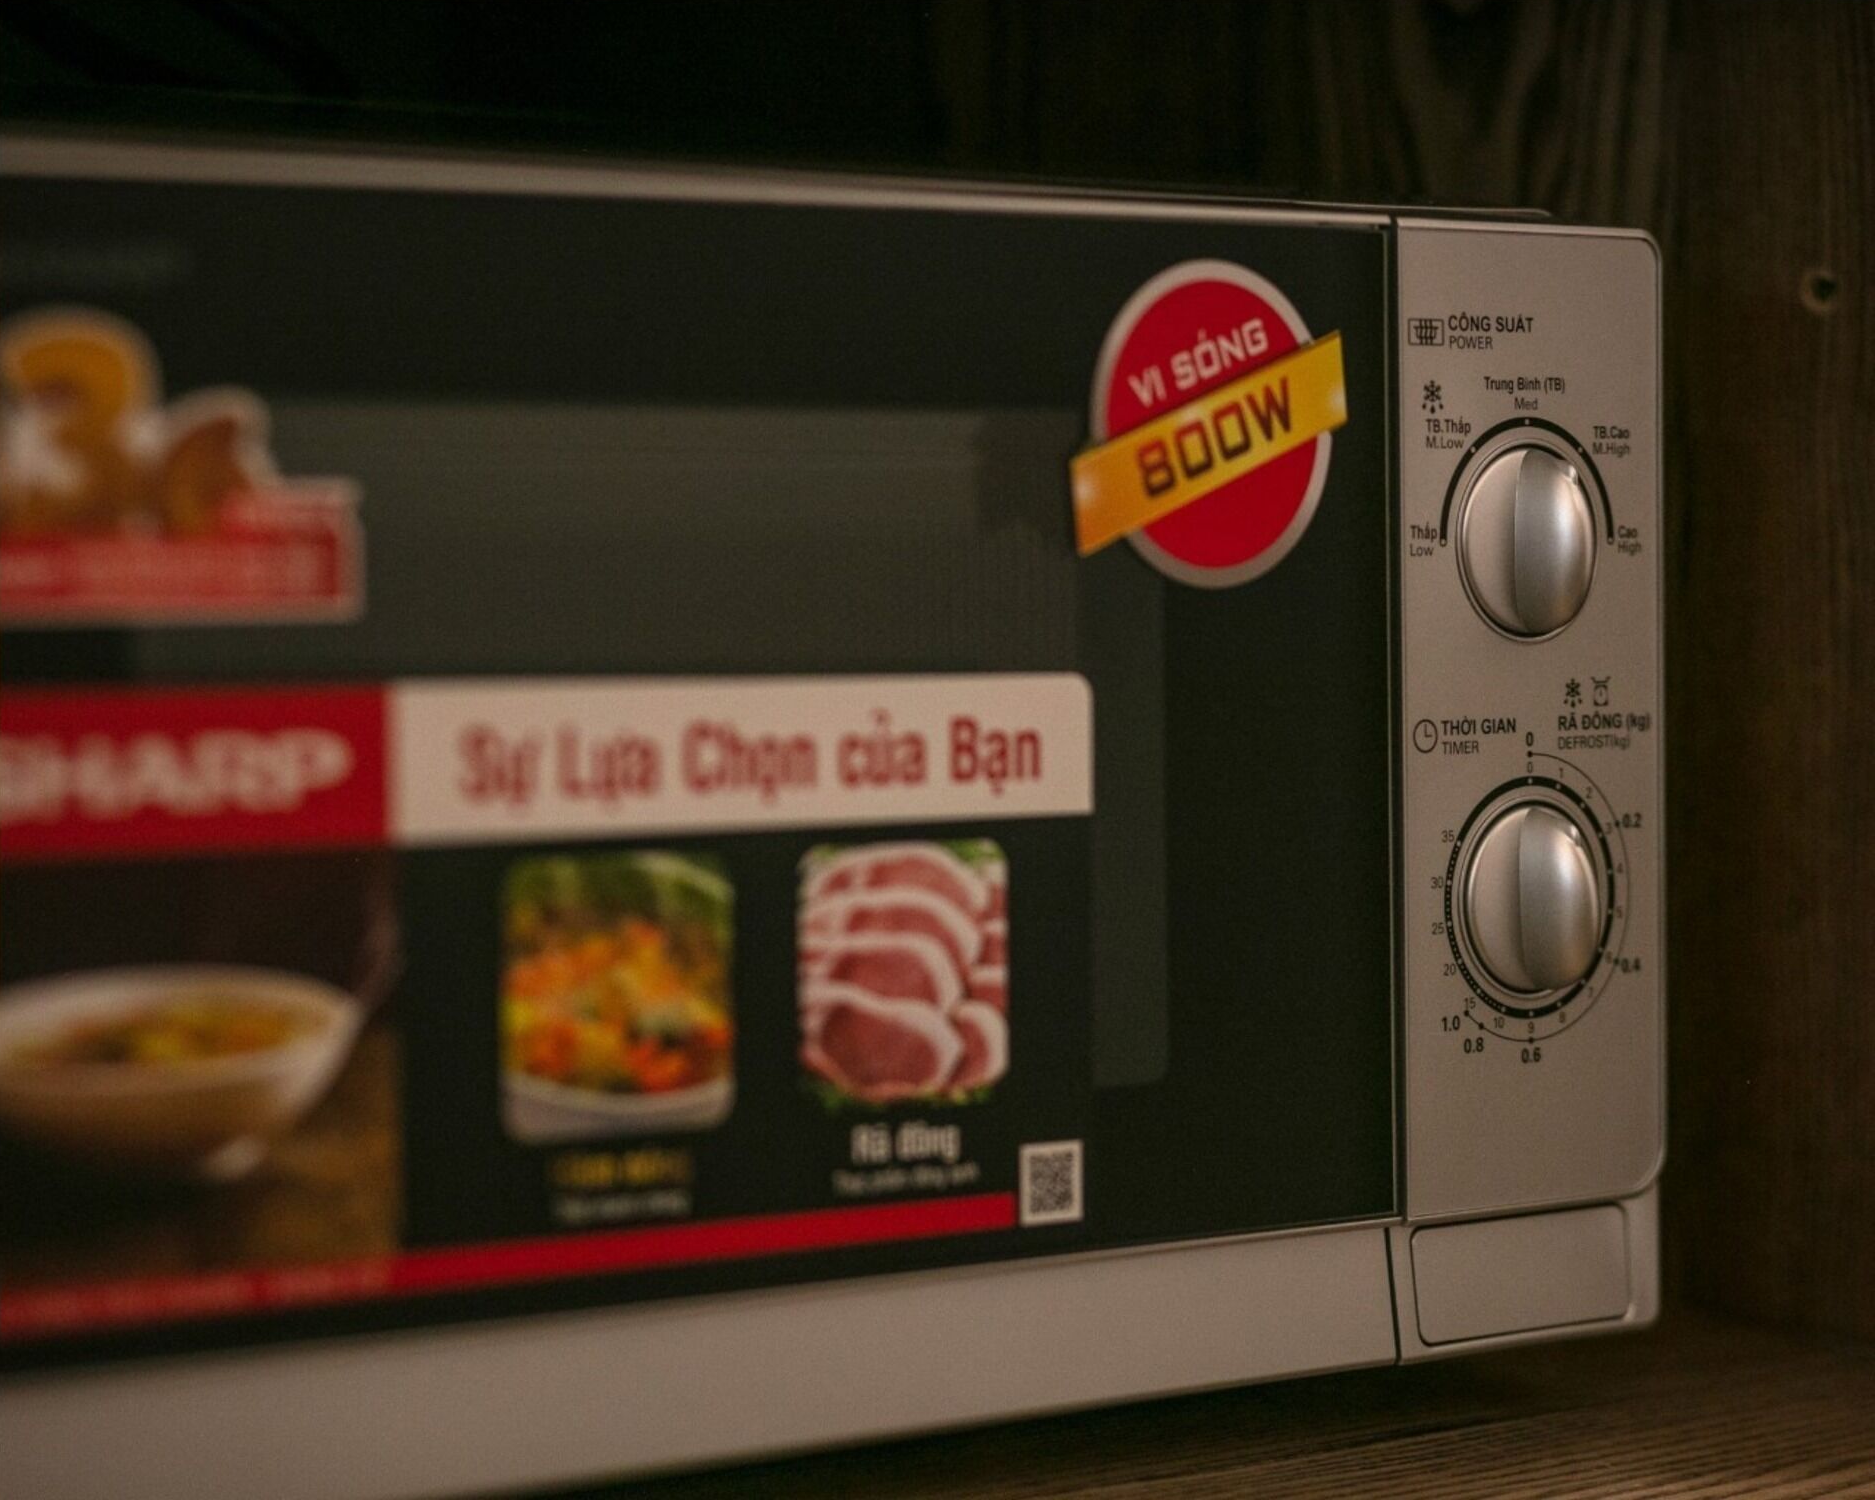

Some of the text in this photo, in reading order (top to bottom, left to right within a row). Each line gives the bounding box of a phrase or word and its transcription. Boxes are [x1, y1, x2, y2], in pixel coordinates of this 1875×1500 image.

[1448, 311, 1491, 332] CÔNG
[1449, 335, 1493, 350] POWER
[1128, 329, 1269, 408] VI SÓNG
[1483, 376, 1514, 394] Trung
[1544, 376, 1566, 394] (TB)
[1514, 397, 1538, 411] Med
[1135, 376, 1291, 498] 800W
[1593, 426, 1630, 440] TB.Cao
[1426, 436, 1465, 449] M.Low
[1592, 442, 1630, 457] M.High
[1618, 525, 1638, 539] Cao
[1410, 543, 1434, 557] Low
[1618, 540, 1642, 556] High
[1480, 718, 1517, 735] GIAN
[1581, 711, 1623, 730] ĐÔNG
[1526, 731, 1534, 747] 0
[679, 716, 819, 804] Chọn
[835, 706, 928, 790] của
[947, 714, 1043, 797] Bạn
[1442, 740, 1479, 755] TIMER
[1527, 761, 1533, 774] 0
[1585, 786, 1593, 799] 2
[1623, 812, 1642, 829] 0.2
[1441, 830, 1455, 843] 35
[1430, 876, 1444, 889] 30
[1431, 922, 1445, 936] 25
[1443, 963, 1457, 977] 20
[1465, 996, 1477, 1010] 15
[1441, 1015, 1461, 1032] 1.0
[1493, 1016, 1505, 1030] 10
[1463, 1037, 1484, 1054] 0.8
[1521, 1047, 1542, 1064] 0.6
